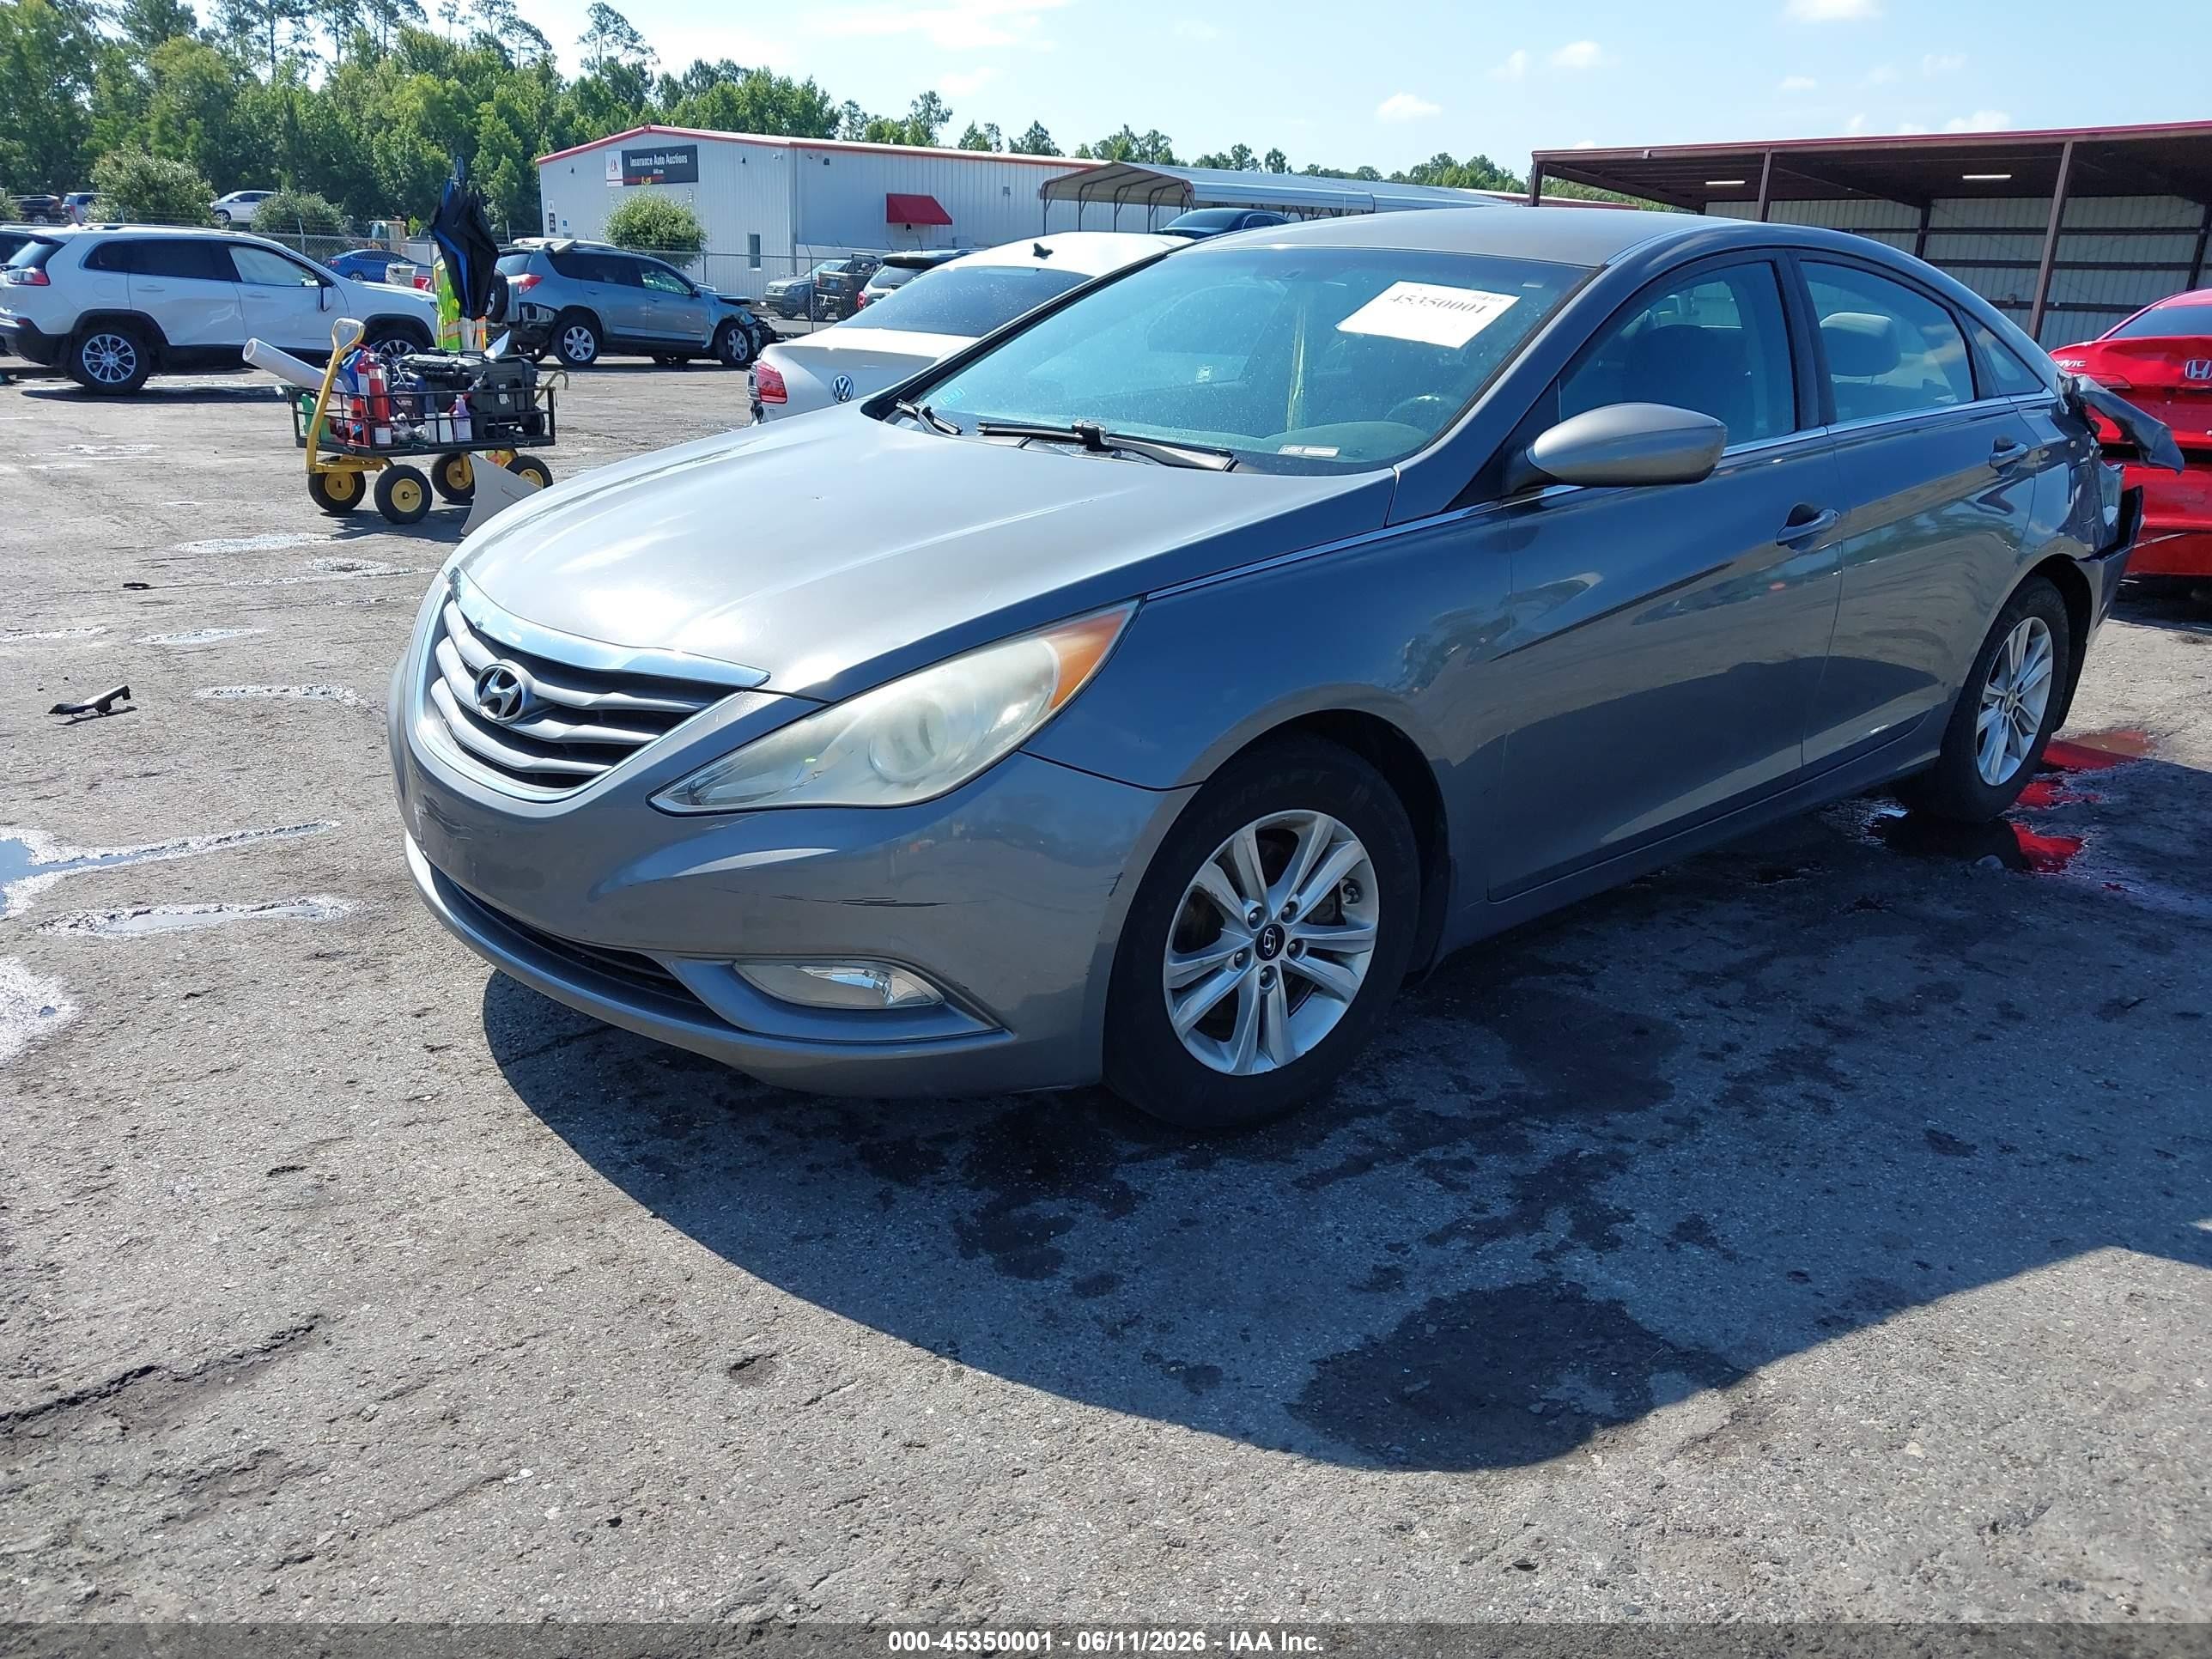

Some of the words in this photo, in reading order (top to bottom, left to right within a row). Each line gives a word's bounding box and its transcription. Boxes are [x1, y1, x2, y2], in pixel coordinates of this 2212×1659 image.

[629, 155, 653, 167] Insurance
[653, 154, 665, 166] Auto
[665, 152, 687, 165] Auctions
